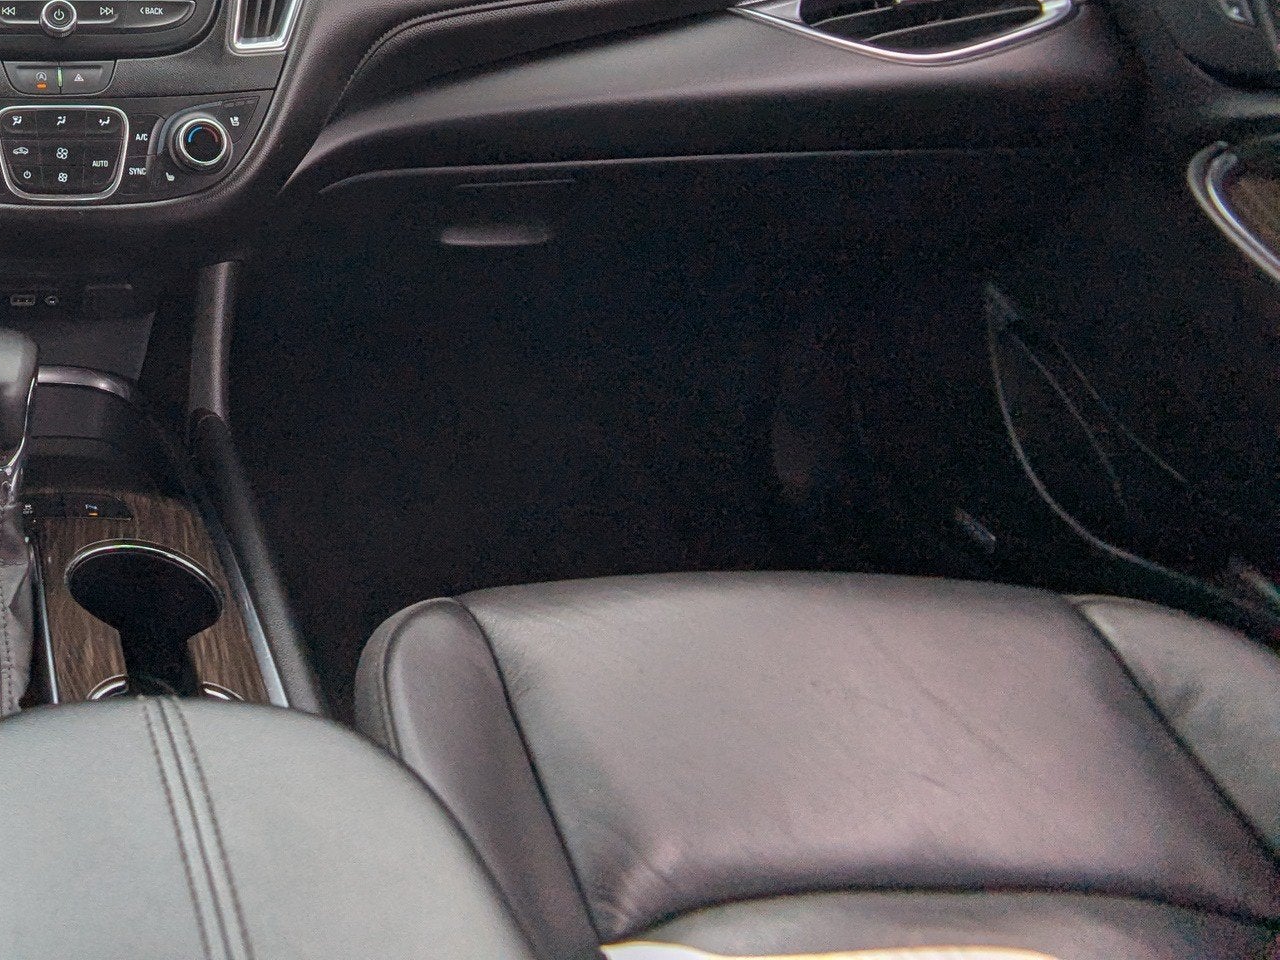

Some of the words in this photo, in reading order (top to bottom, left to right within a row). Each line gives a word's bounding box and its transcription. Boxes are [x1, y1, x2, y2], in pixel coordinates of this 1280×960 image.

[144, 6, 163, 15] BACK
[135, 133, 148, 141] A/C
[128, 167, 147, 176] SYNC
